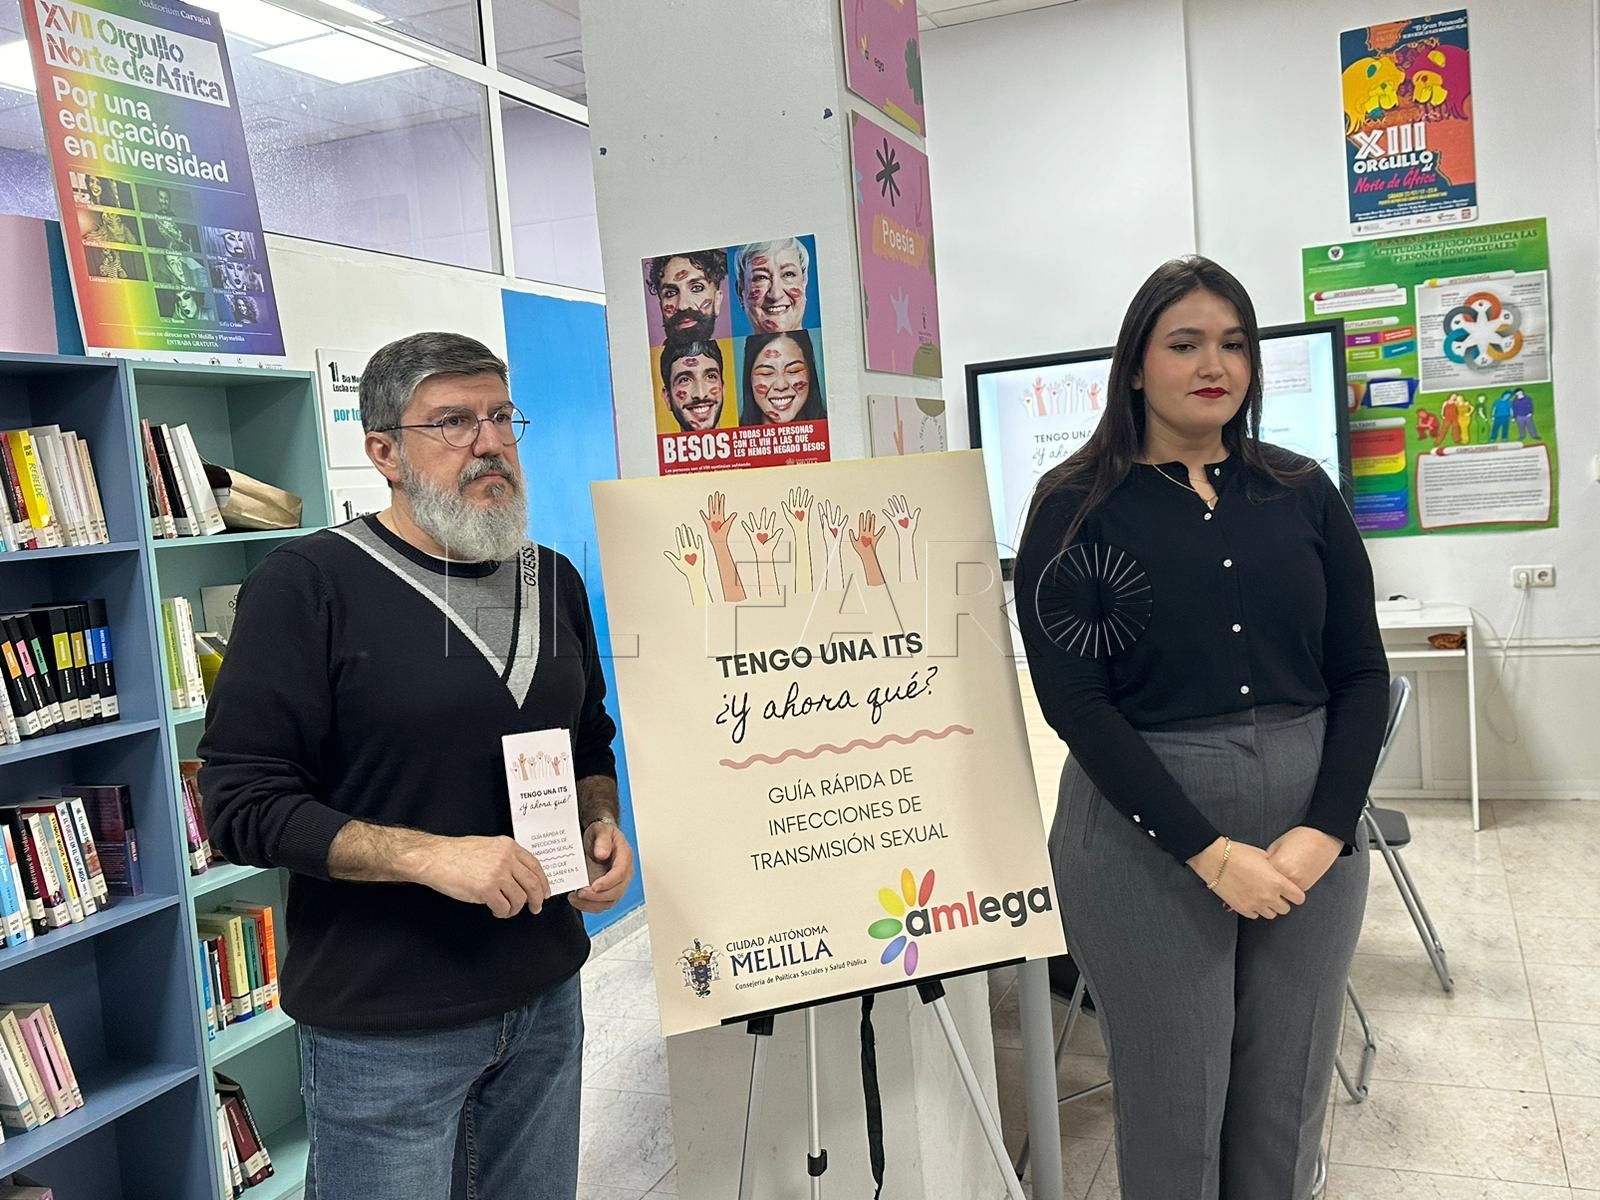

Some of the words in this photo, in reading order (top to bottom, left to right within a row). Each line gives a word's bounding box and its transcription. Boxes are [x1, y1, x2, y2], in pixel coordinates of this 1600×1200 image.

[39, 1, 94, 39] XVII
[97, 18, 184, 63] Orgullo
[180, 10, 211, 26] Carvajal
[47, 33, 120, 75] Norte
[122, 52, 154, 84] de
[52, 75, 97, 106] Por
[105, 93, 152, 122] una
[59, 106, 191, 154] educación
[1353, 121, 1426, 159] XIII
[63, 136, 97, 160] en
[103, 138, 229, 183] diversidad
[1353, 151, 1433, 174] ORGULLO
[1354, 177, 1384, 194] Norte
[1387, 175, 1400, 189] de
[882, 219, 915, 256] Poesía
[1392, 251, 1439, 262] PERSONAS
[1442, 242, 1518, 256] HOMOSEXUALES
[1425, 236, 1487, 249] PREJUICIOSAS
[1489, 231, 1518, 241] HACIA
[1520, 229, 1537, 239] LAS
[333, 408, 350, 423] por
[739, 429, 761, 439] TODAS
[763, 427, 776, 437] LAS
[777, 425, 814, 436] PERSONAS
[662, 432, 730, 464] BESOS
[733, 439, 748, 449] CON
[749, 438, 757, 447] EL
[759, 437, 771, 446] VIH
[773, 436, 779, 445] A
[780, 435, 793, 444] LAS
[794, 434, 808, 443] QUE
[734, 448, 746, 458] LES
[747, 446, 771, 456] HEMOS
[773, 444, 801, 454] NEGADO
[802, 442, 825, 451] BESOS
[1034, 432, 1069, 443] TENGO
[28, 463, 44, 498] REBELDE
[522, 546, 536, 587] GUESS
[716, 646, 812, 678] TENGO
[820, 639, 877, 664] UNA
[883, 632, 923, 657] ITS
[716, 692, 750, 744] ¿Y
[763, 682, 858, 720] ahora
[867, 666, 938, 724] qué?
[520, 790, 543, 799] TENGO
[543, 788, 556, 797] UNA
[558, 786, 568, 794] ITS
[768, 779, 816, 804] GUÍA
[820, 771, 886, 797] RÁPIDA
[890, 766, 914, 785] DE
[530, 799, 551, 810] ahora
[769, 800, 894, 836] INFECCIONES
[898, 795, 923, 814] DE
[750, 833, 875, 871] TRANSMISIÓN
[881, 822, 949, 848] SEXUAL
[905, 884, 1053, 938] amlega
[726, 936, 765, 952] CIUDAD
[767, 925, 829, 945] AUTÓNOMA
[730, 938, 833, 977] MELILLA
[766, 976, 774, 984] de
[800, 967, 824, 977] Sociales
[829, 963, 846, 972] Salud
[846, 958, 867, 968] Pública
